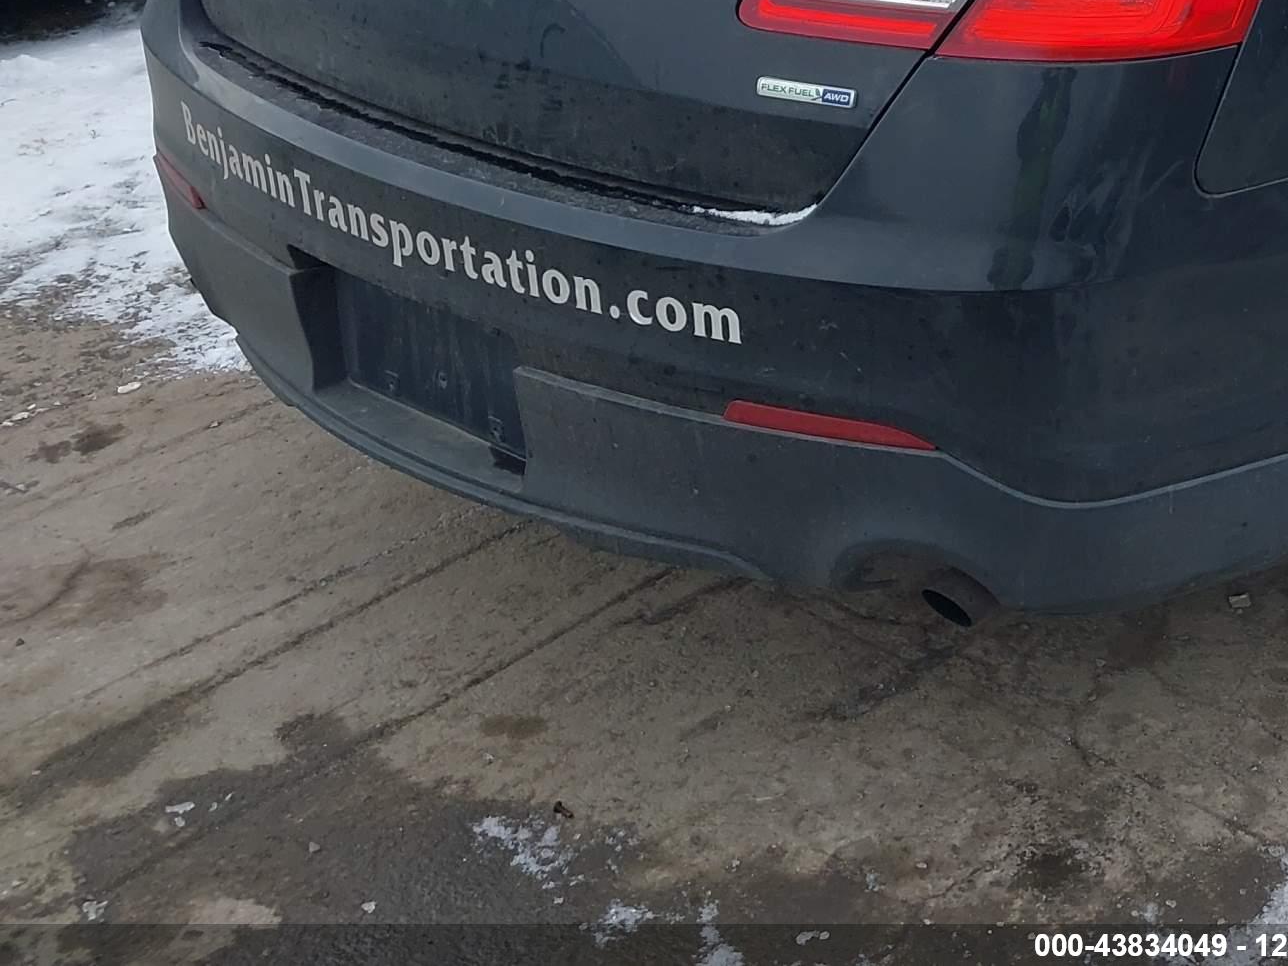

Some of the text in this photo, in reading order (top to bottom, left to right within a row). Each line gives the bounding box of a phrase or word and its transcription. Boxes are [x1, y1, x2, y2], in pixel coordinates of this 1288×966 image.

[761, 83, 850, 103] FLEX FUEL AWD
[180, 100, 743, 345] BenjaminTransportation.com
